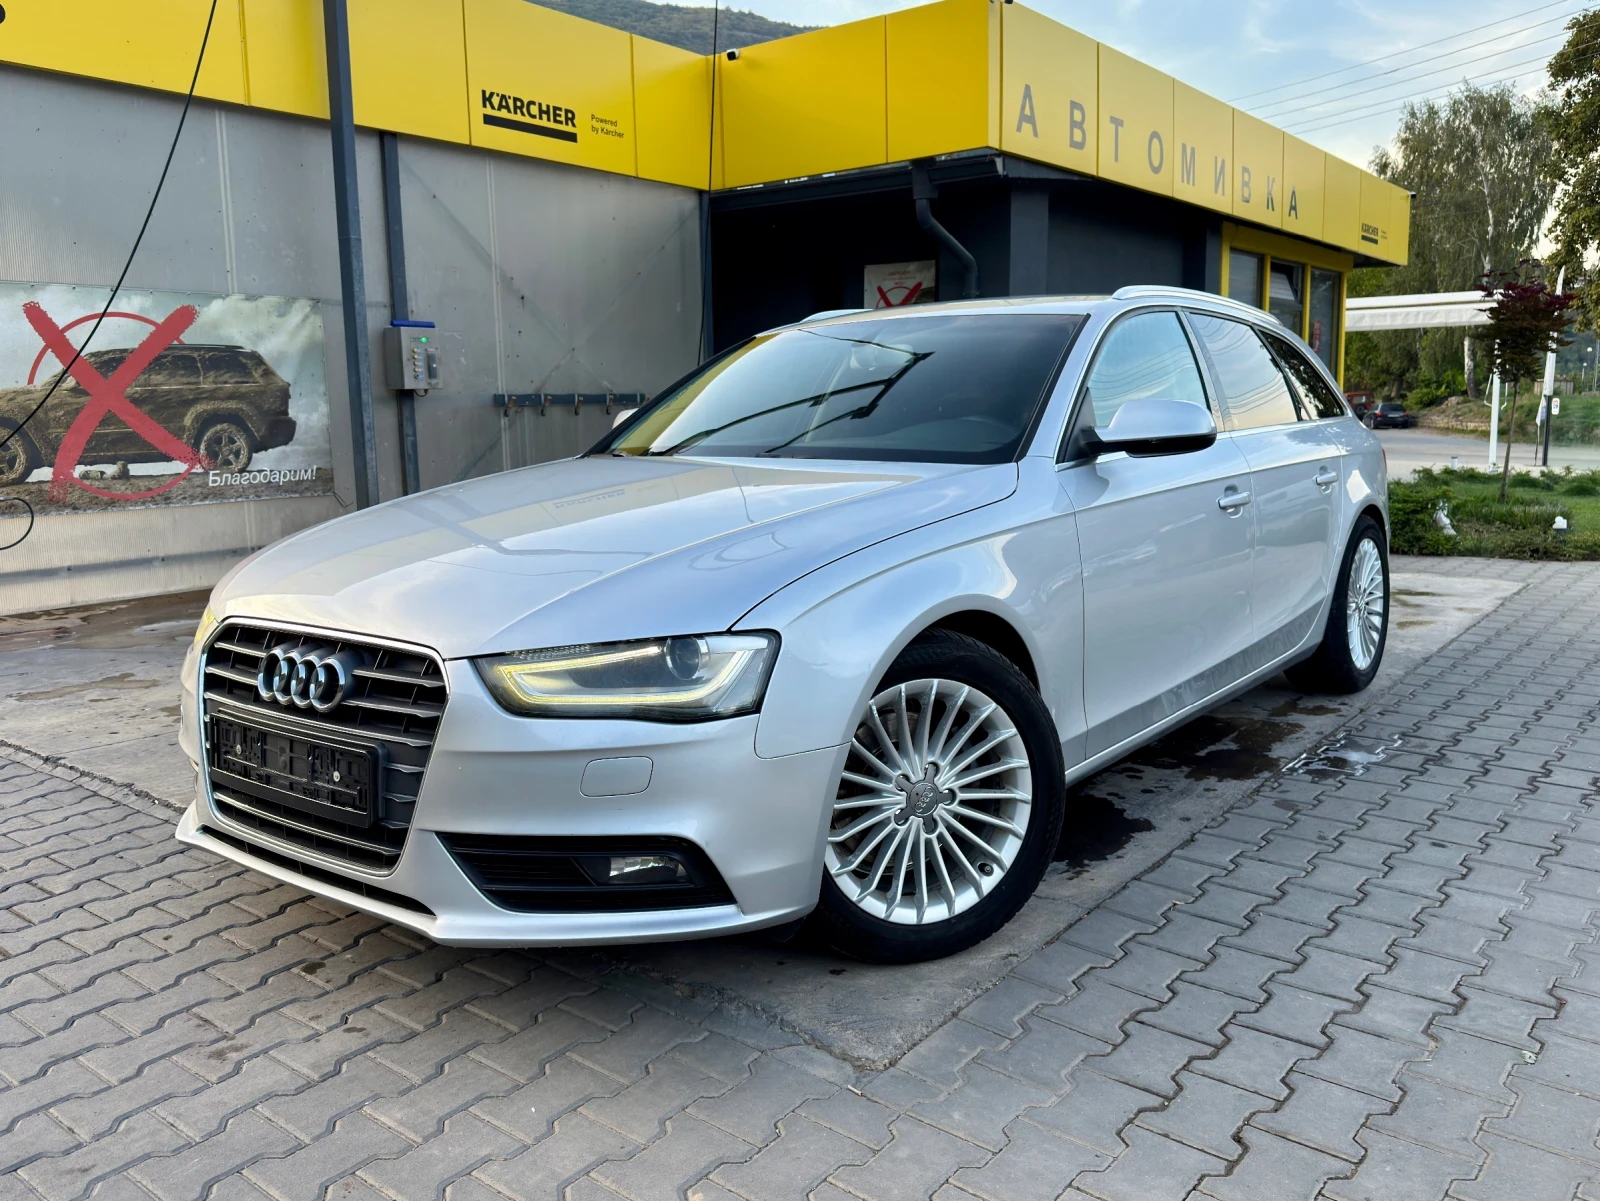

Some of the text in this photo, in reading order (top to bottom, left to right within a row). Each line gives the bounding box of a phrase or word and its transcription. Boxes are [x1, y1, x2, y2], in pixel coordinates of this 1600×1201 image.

[481, 89, 577, 128] KÄRCHER
[591, 114, 618, 127] Powered
[591, 125, 599, 134] by
[1016, 84, 1299, 220] АВТОМИВКА
[208, 465, 317, 487] Благодарим!
